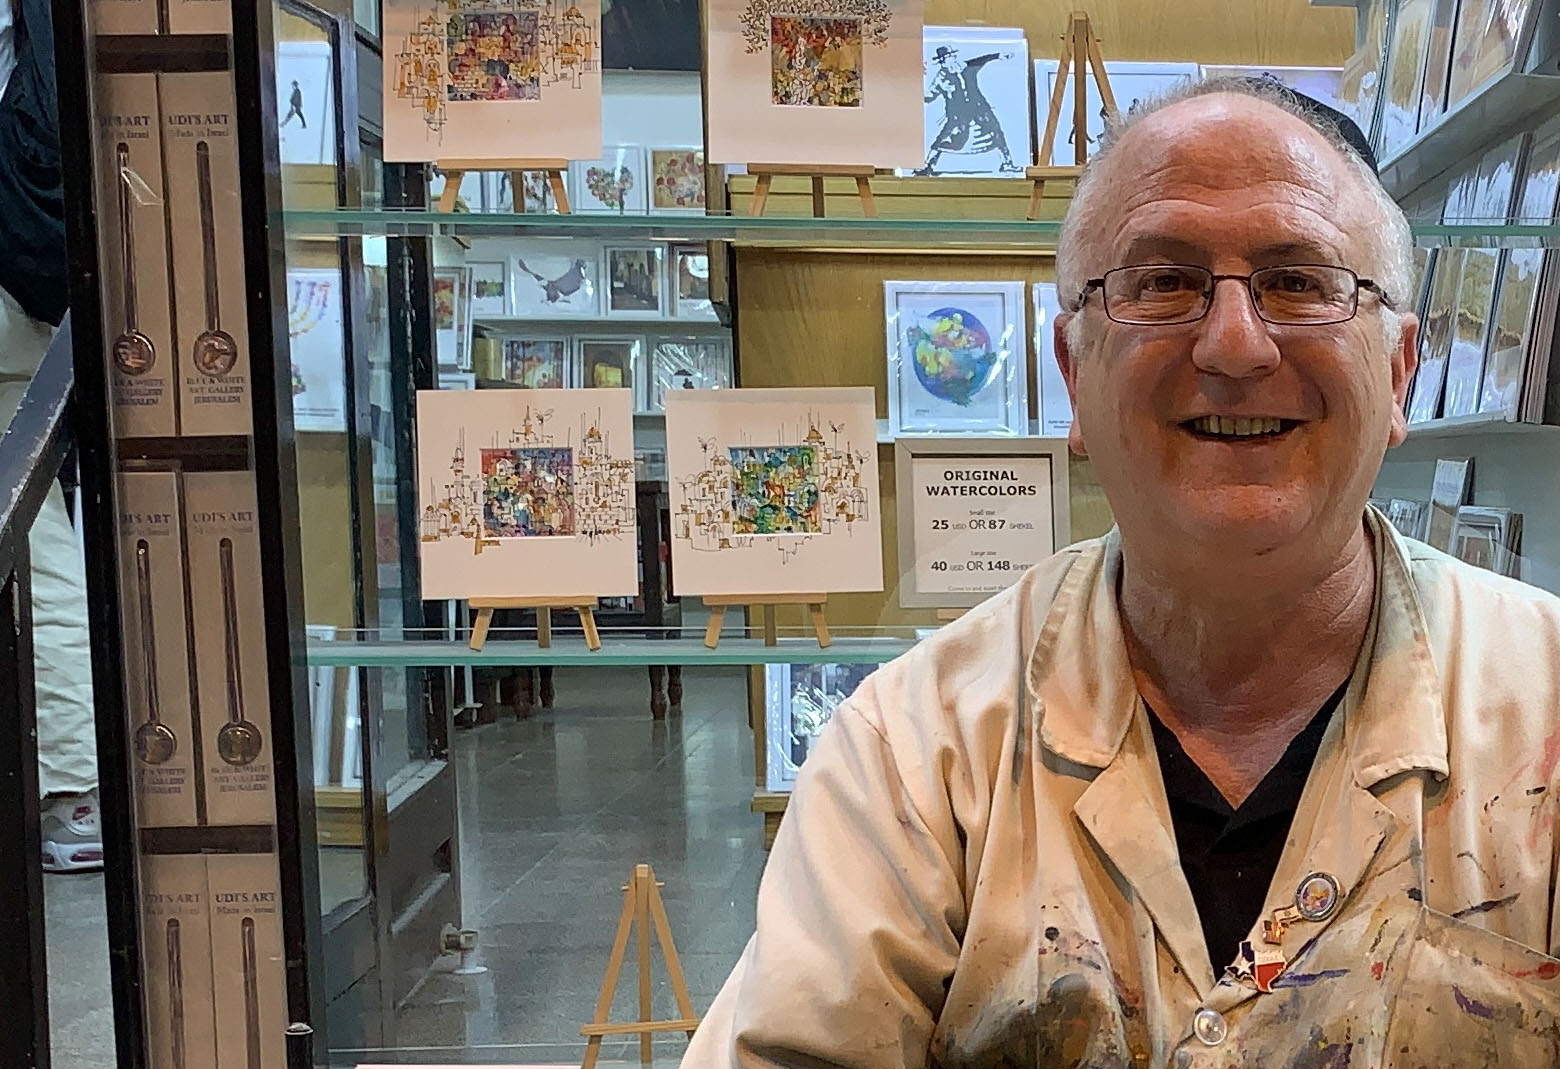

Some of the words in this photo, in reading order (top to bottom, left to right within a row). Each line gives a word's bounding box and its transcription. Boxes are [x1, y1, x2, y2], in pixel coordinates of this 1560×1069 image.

[125, 115, 150, 126] ART
[168, 114, 202, 125] UDI'S
[204, 114, 229, 125] ART
[943, 470, 1018, 481] ORIGINAL
[926, 485, 1037, 496] WATERCOLORS
[146, 513, 171, 524] ART
[192, 512, 226, 523] UDI'S
[229, 511, 253, 522] ART
[932, 519, 949, 530] 25
[969, 519, 986, 530] OR
[988, 519, 1006, 530] 87
[930, 561, 947, 571] 40
[966, 560, 985, 571] OR
[987, 560, 1010, 571] 148
[179, 893, 200, 904] ART
[215, 892, 249, 903] UDI'S
[252, 892, 276, 903] ART
